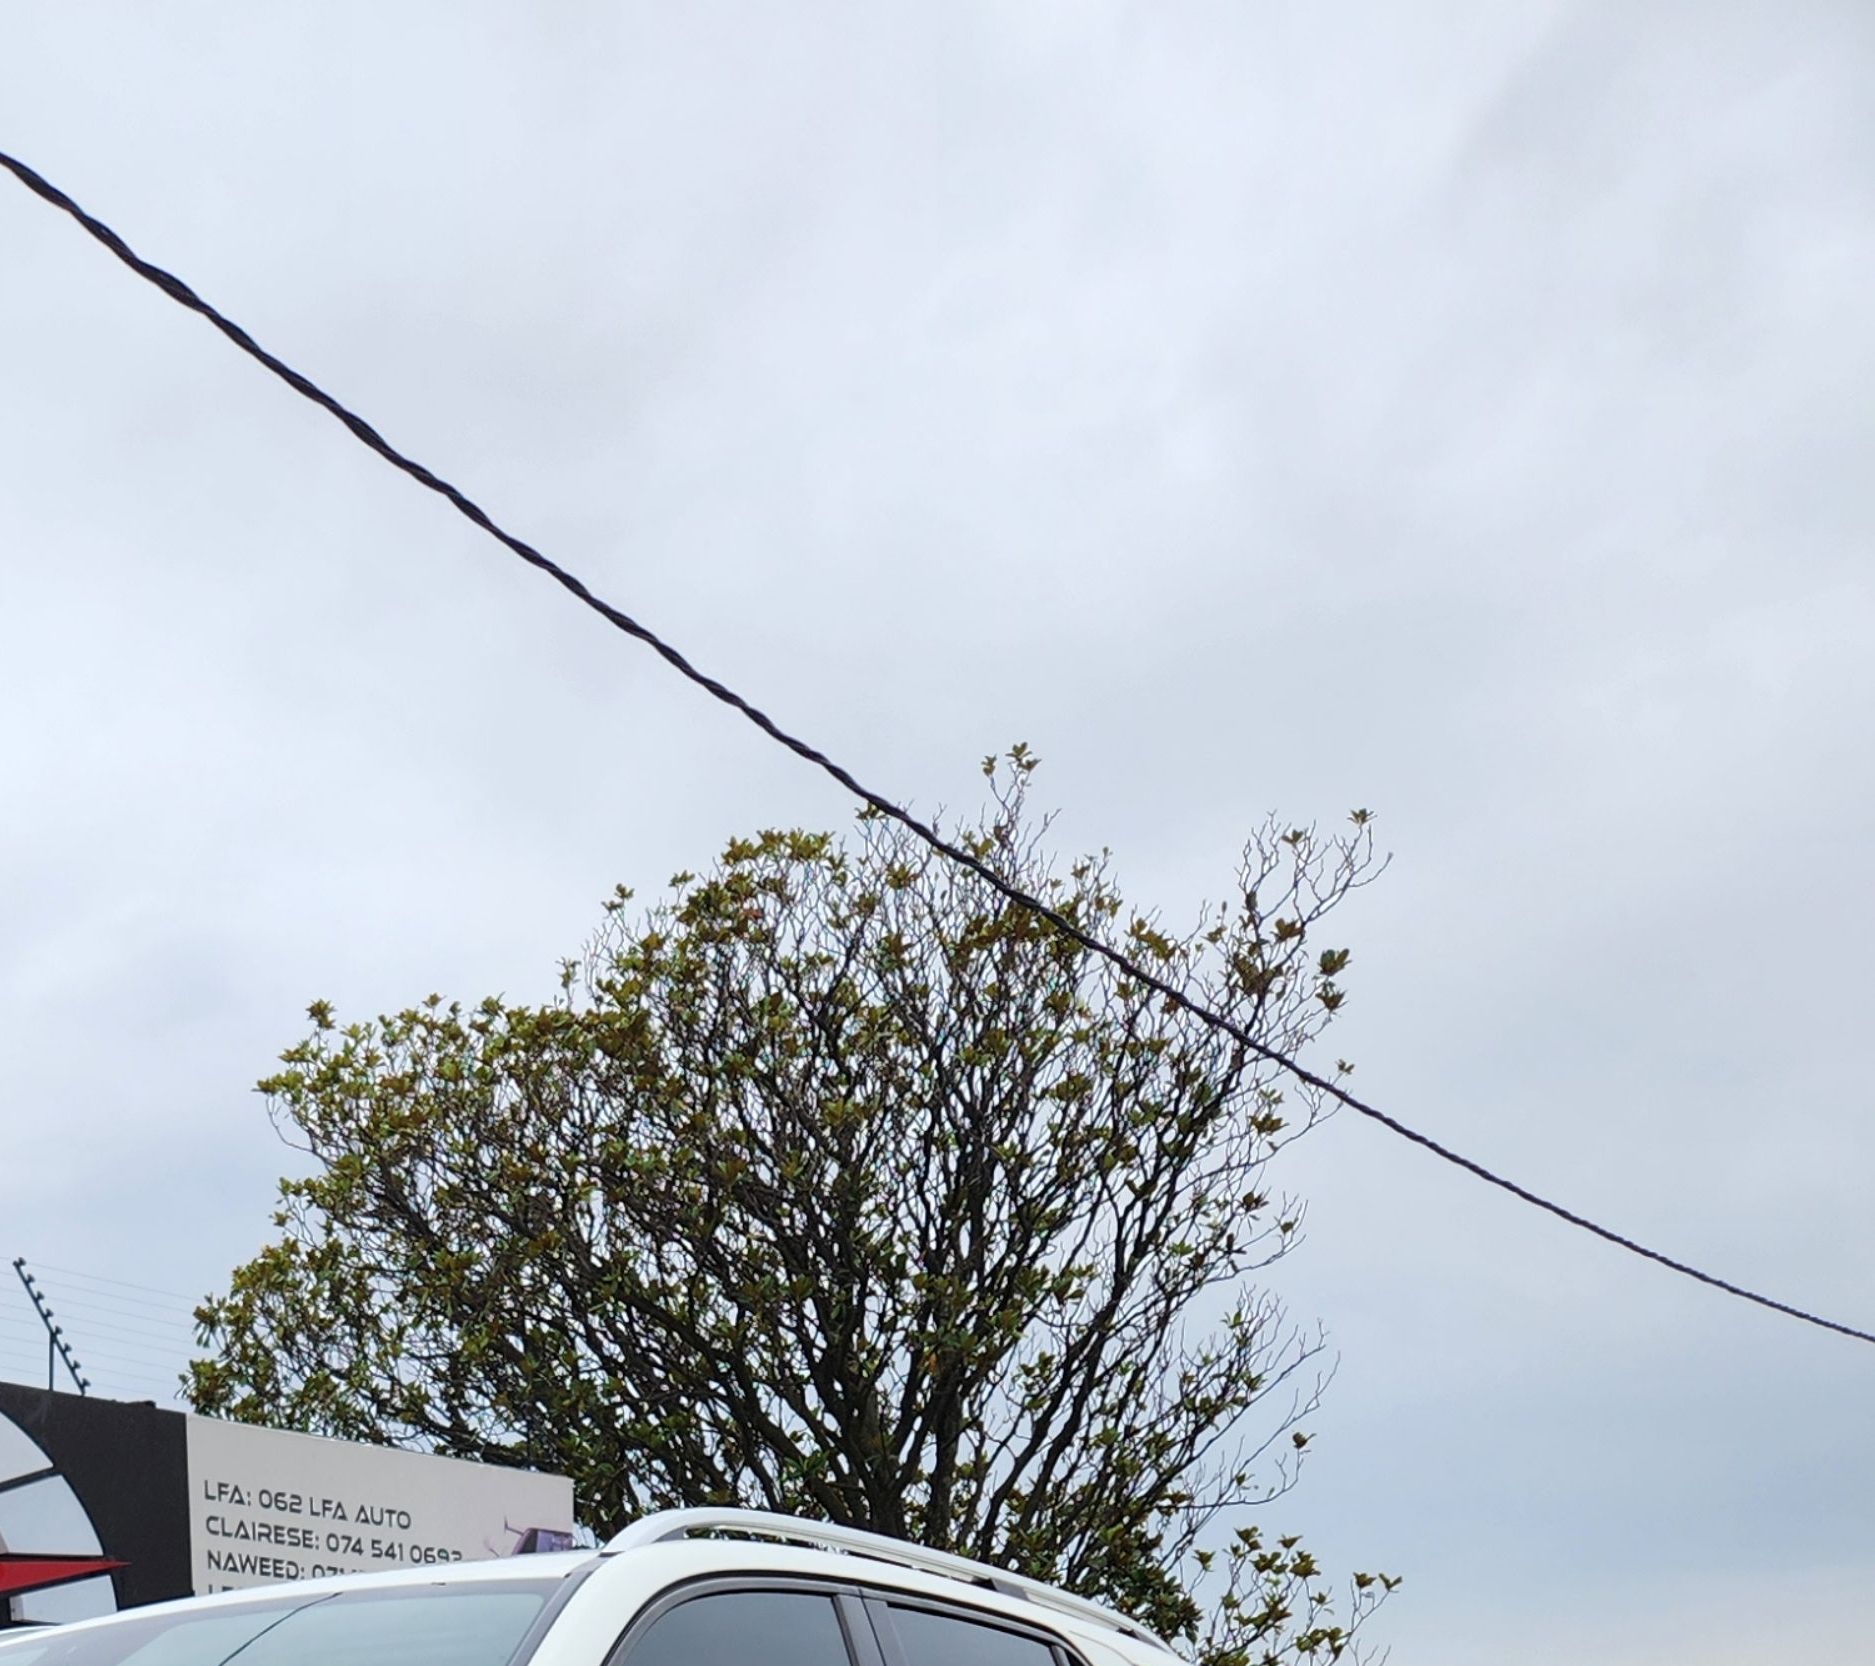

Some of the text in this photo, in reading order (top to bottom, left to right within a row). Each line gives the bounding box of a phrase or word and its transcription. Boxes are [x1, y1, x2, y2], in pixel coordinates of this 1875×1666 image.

[203, 1480, 412, 1531] LFA: 062 LFA AUTO
[206, 1516, 320, 1550] CLAIRESE:
[326, 1534, 365, 1557] 074
[371, 1540, 404, 1562] 541
[207, 1550, 305, 1580] NAWEED:
